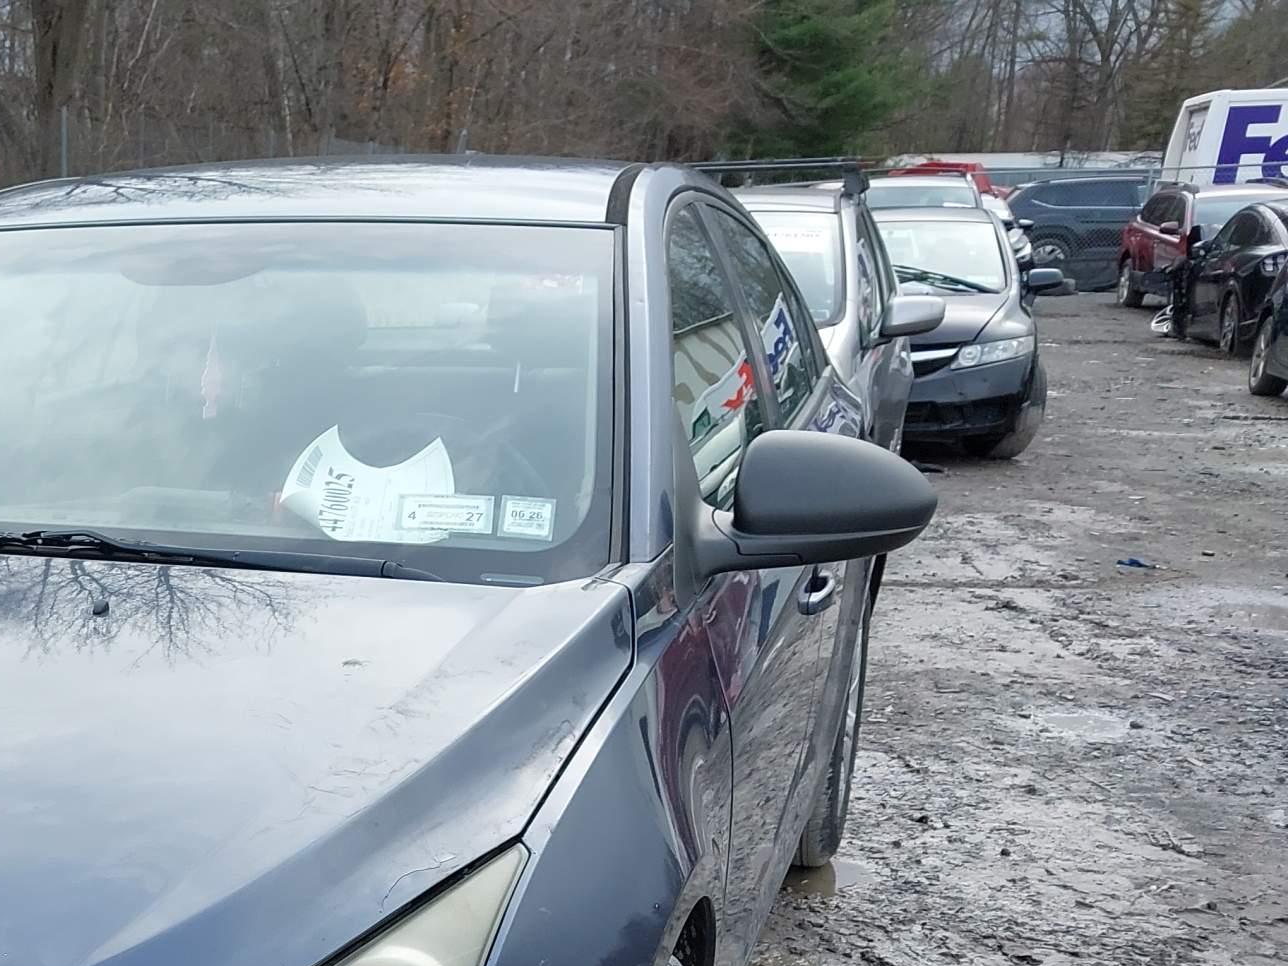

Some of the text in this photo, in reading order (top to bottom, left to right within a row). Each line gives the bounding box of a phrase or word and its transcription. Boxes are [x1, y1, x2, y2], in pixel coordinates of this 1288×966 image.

[318, 466, 356, 532] 44760025
[407, 511, 417, 520] 4
[465, 511, 484, 522] 27
